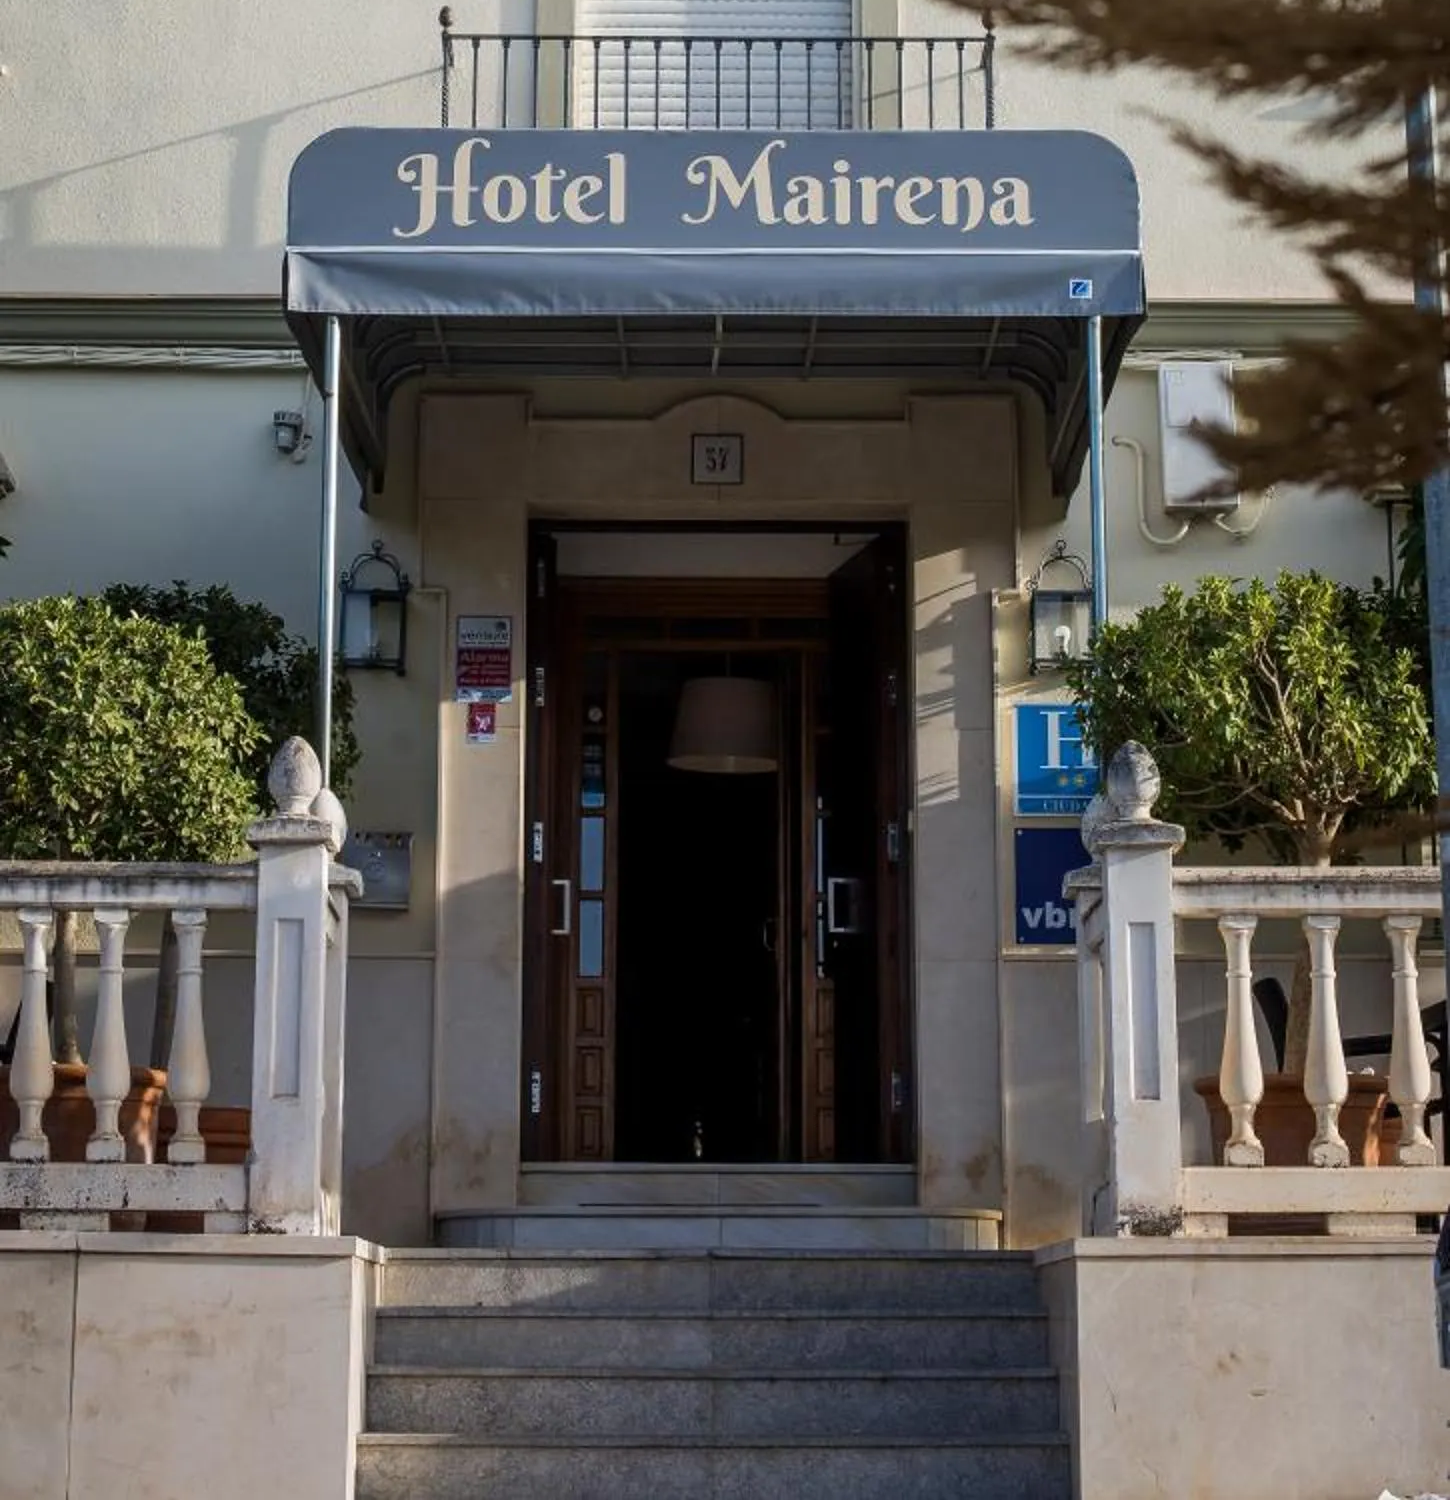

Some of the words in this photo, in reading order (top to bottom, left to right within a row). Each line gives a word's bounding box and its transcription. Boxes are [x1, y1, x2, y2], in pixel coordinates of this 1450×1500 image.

[393, 137, 627, 237] Hotel
[682, 139, 1035, 233] Mairena
[1040, 711, 1099, 769] H
